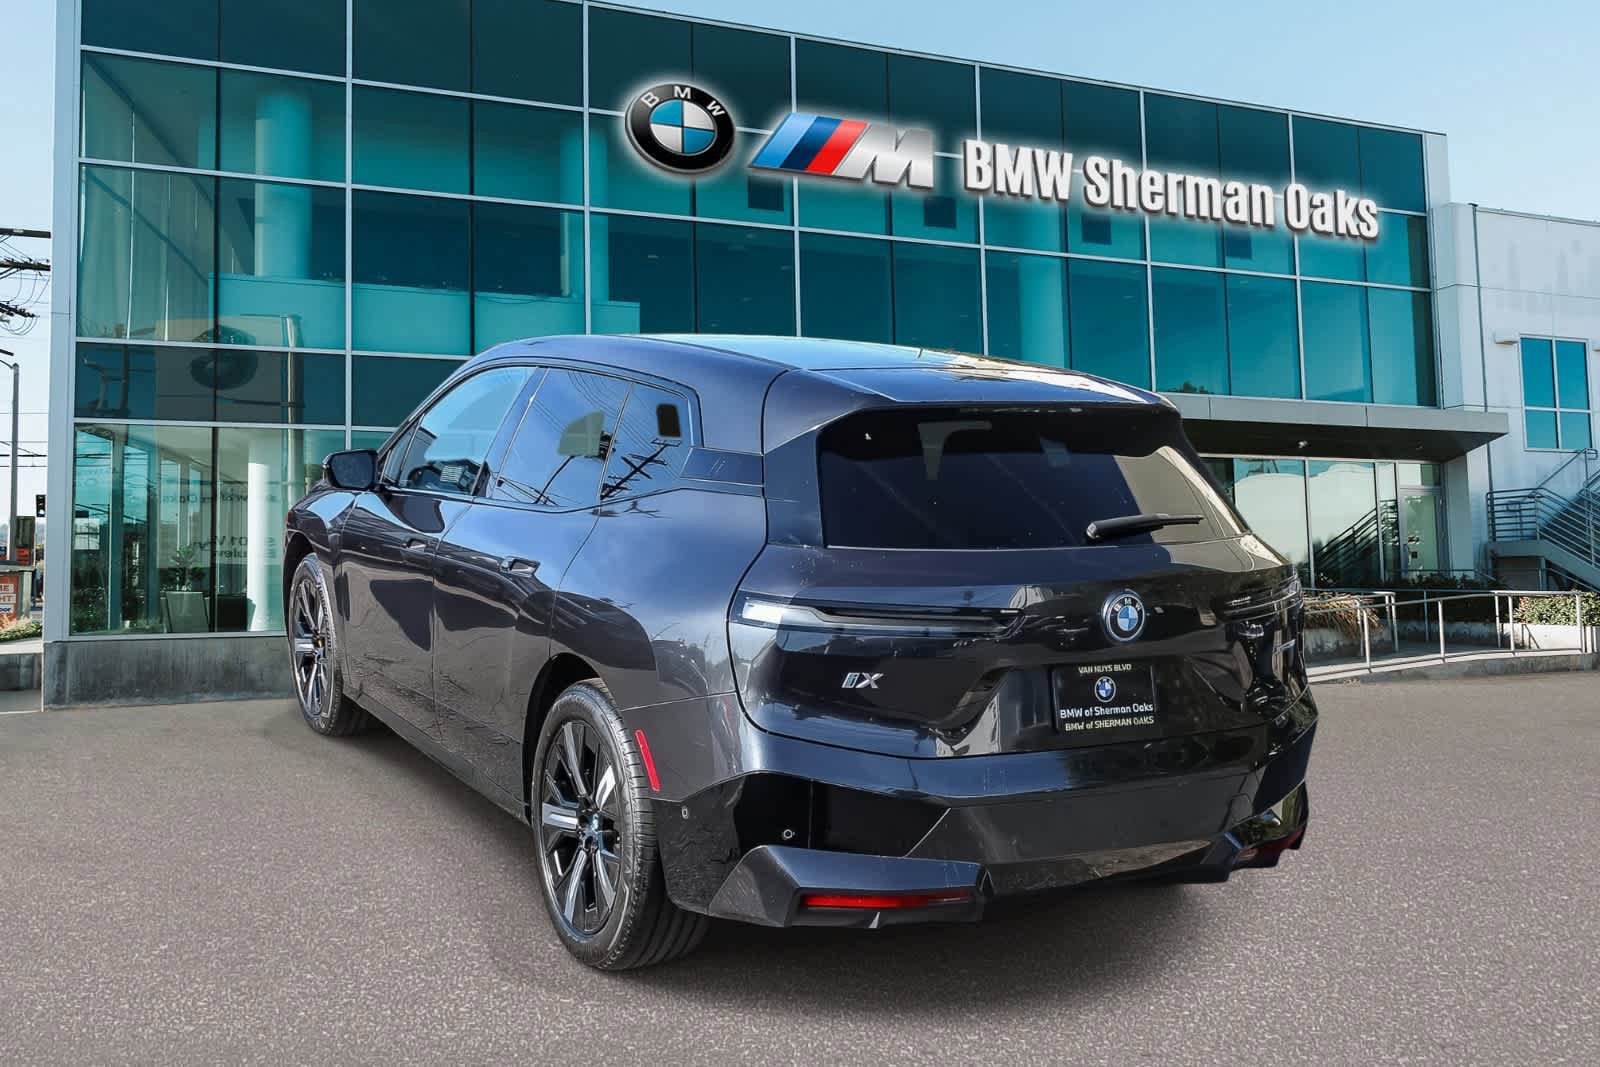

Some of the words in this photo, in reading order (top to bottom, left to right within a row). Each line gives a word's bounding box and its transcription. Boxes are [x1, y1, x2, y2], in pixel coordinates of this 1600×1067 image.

[641, 85, 726, 118] BMW
[963, 139, 1073, 201] BMW
[1083, 155, 1275, 227] Sherman
[1284, 183, 1379, 240] Oaks
[1078, 666, 1093, 674] VAN
[1094, 664, 1112, 673] NUYS
[1113, 663, 1132, 672] BLVD
[1060, 707, 1083, 719] BMW
[1084, 706, 1093, 716] of
[1094, 705, 1131, 716] Sherman
[1132, 702, 1154, 712] Oaks
[1065, 722, 1084, 732] BMW
[1086, 720, 1093, 729] of
[1095, 718, 1132, 729] SHERMAN
[1133, 715, 1155, 725] OAKS
